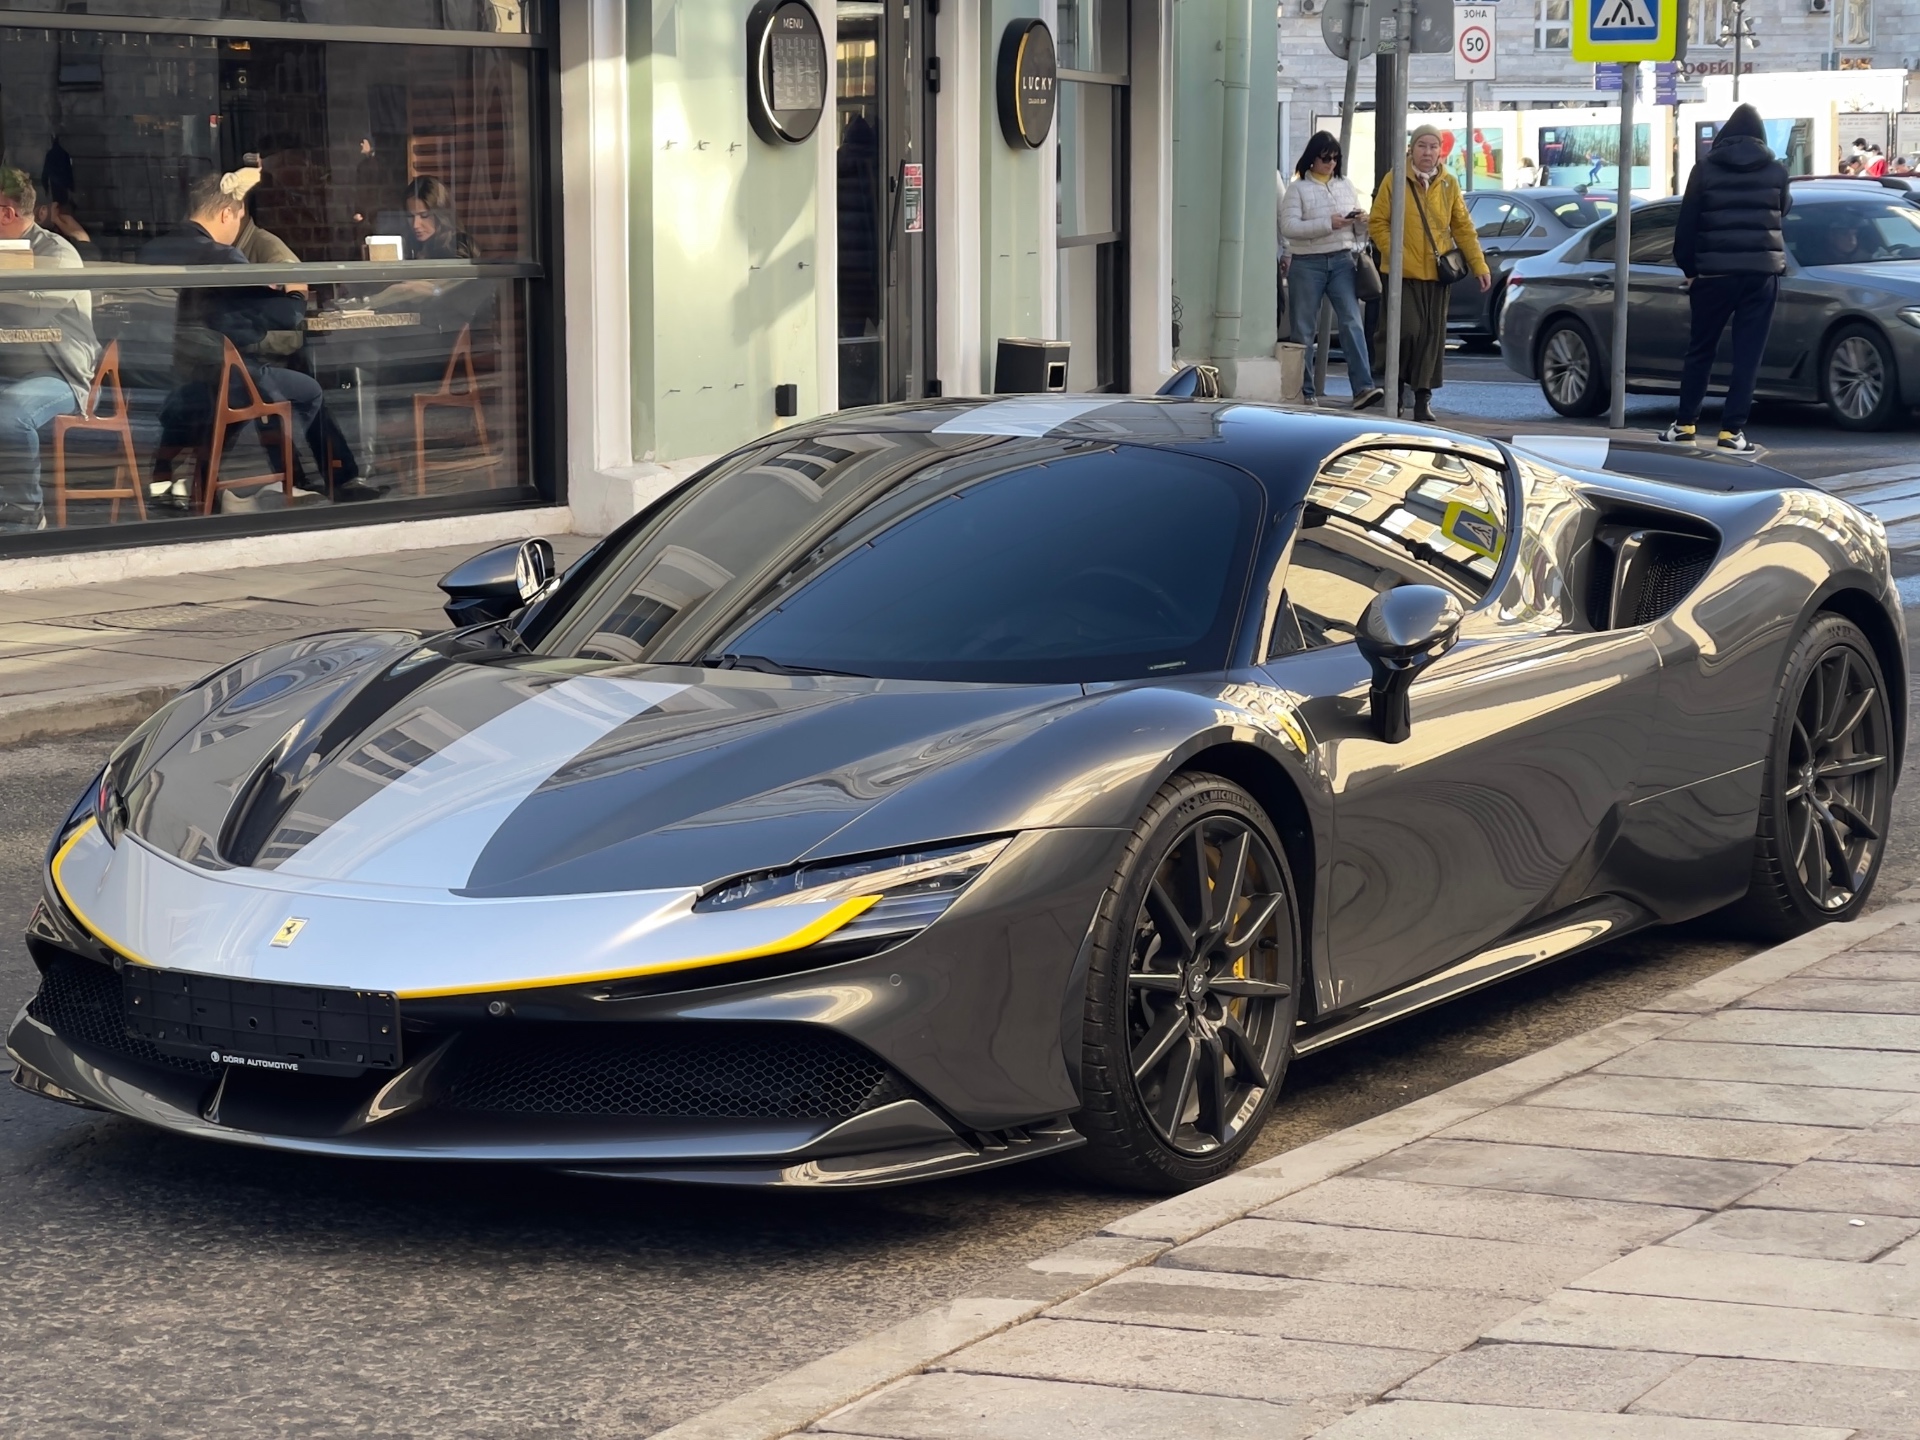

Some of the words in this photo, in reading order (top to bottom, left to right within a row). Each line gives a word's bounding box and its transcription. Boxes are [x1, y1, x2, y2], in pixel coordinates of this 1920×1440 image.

[1464, 9, 1488, 19] ЗОНА
[783, 17, 804, 29] MENU
[1466, 37, 1484, 52] 50
[1022, 76, 1053, 91] LUCKY
[222, 1055, 245, 1065] DÖRR
[246, 1058, 299, 1071] AUTOMOTIVE
